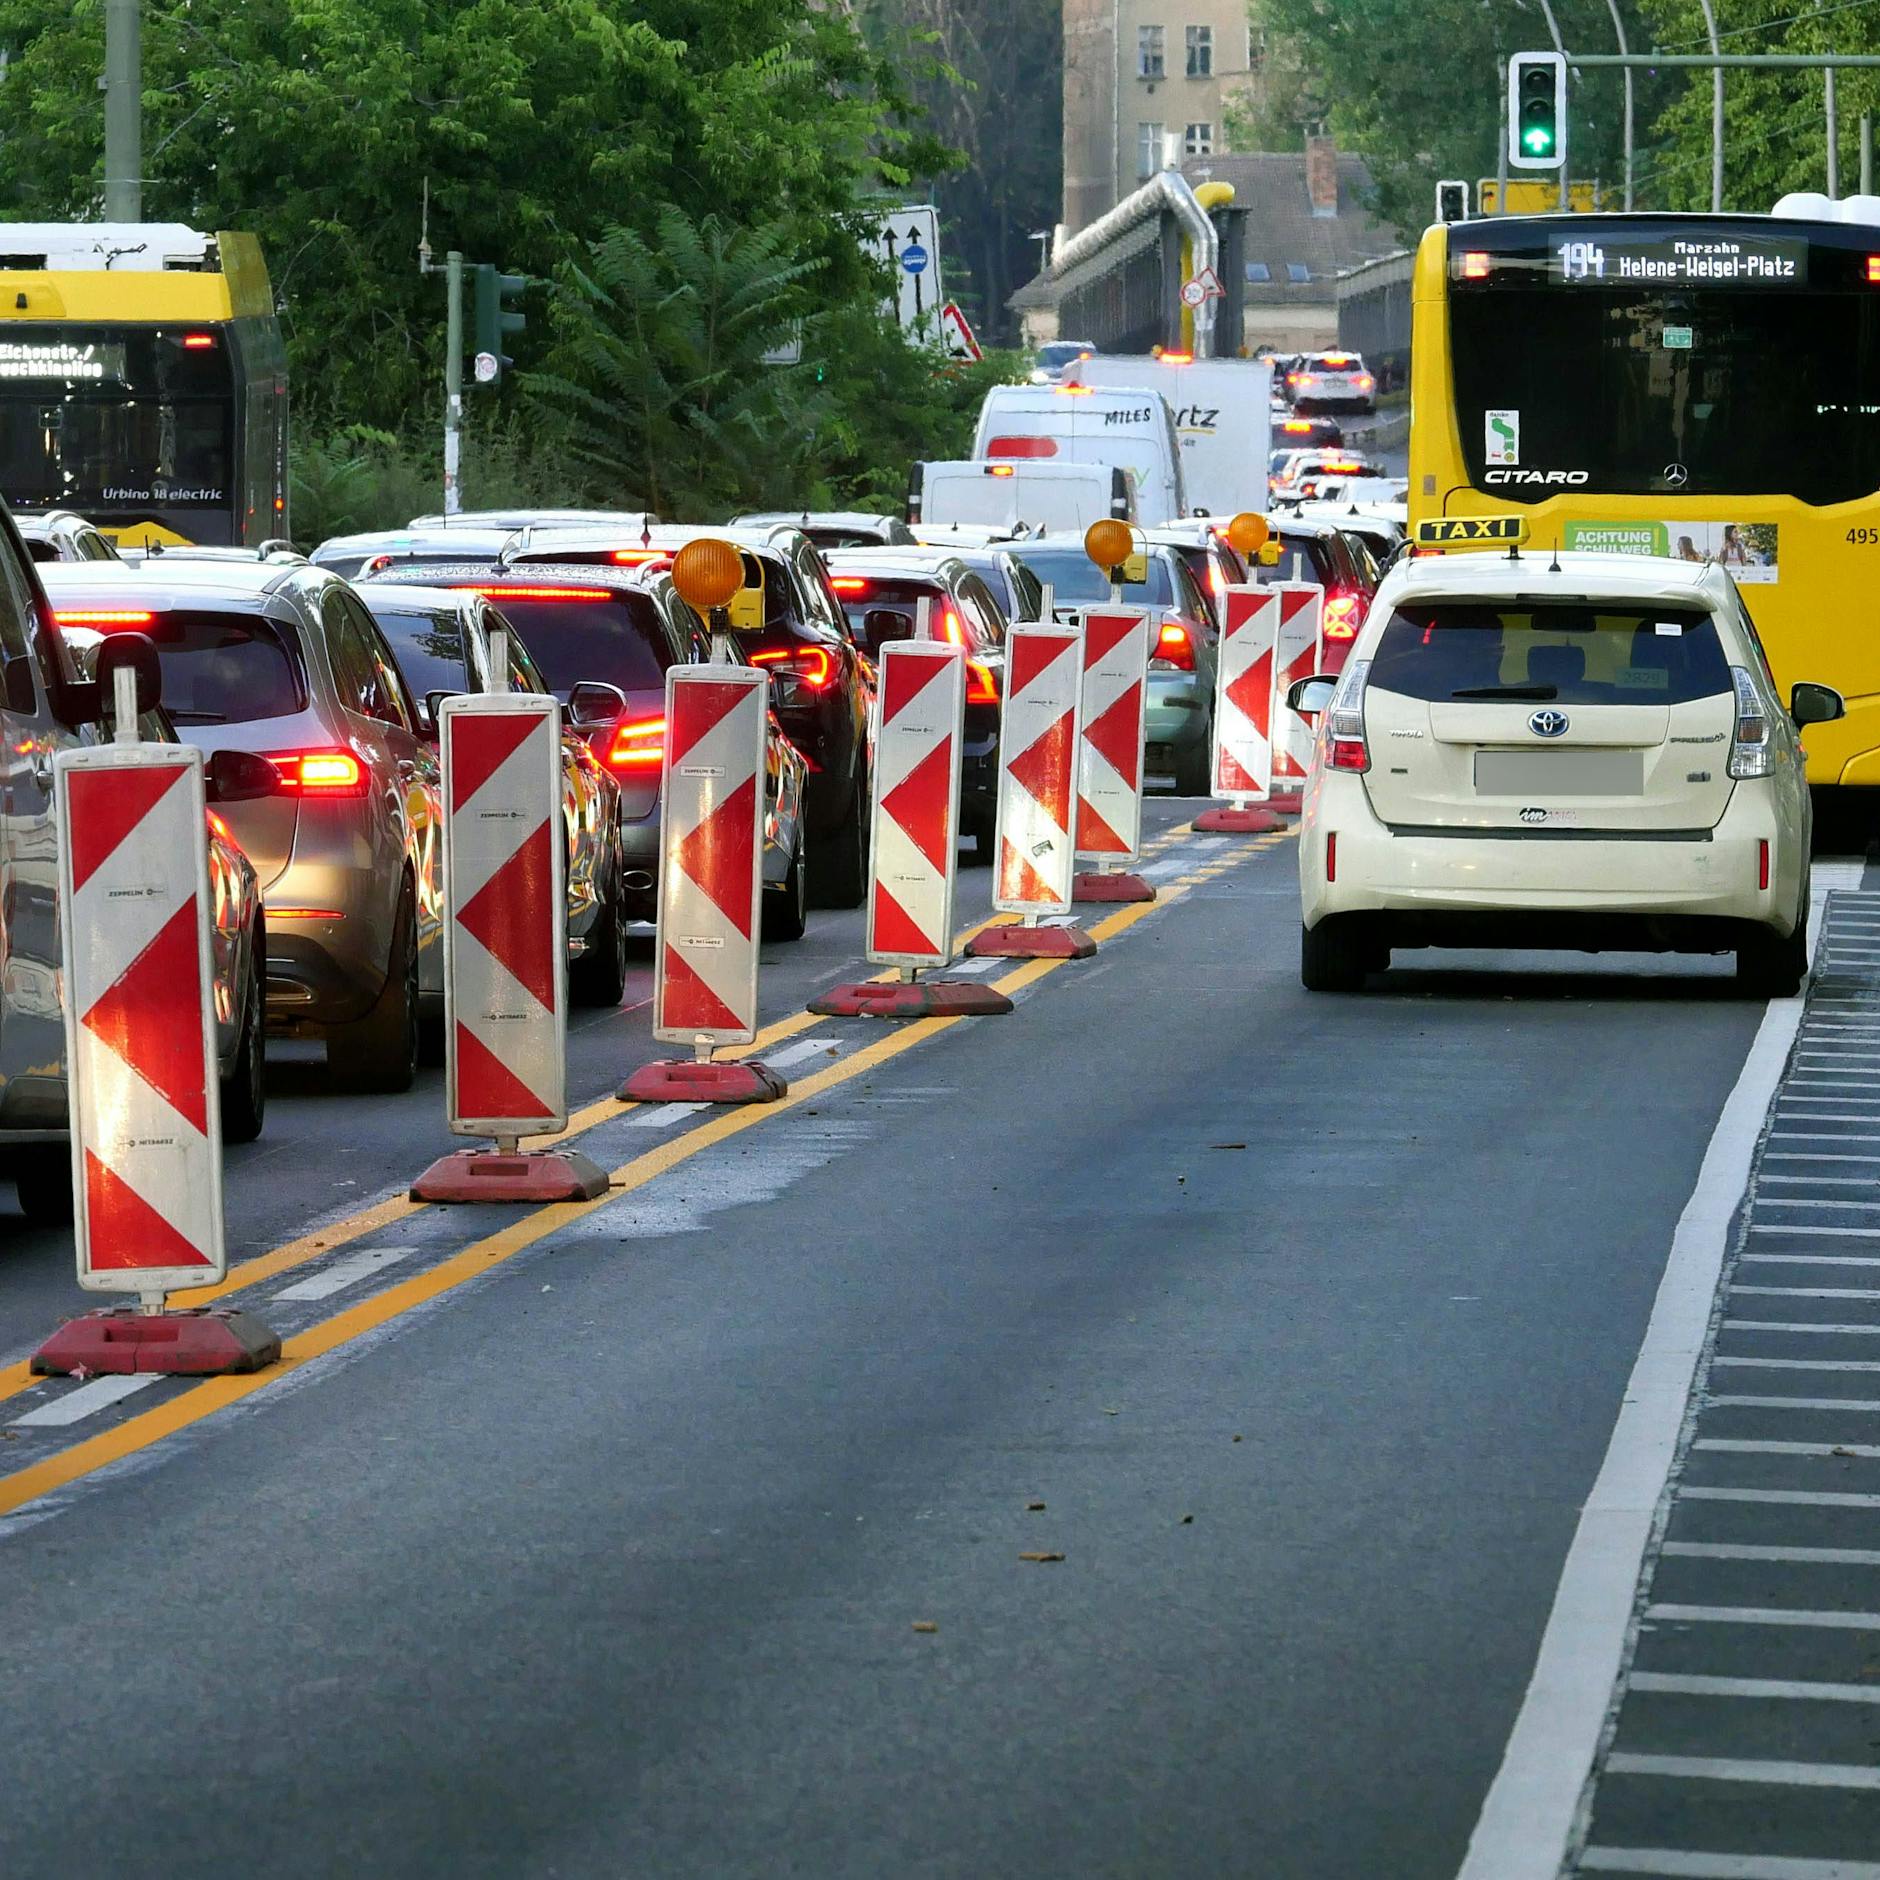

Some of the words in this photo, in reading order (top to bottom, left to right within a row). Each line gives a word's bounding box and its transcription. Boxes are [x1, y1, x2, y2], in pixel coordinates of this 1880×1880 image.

[1674, 242, 1740, 254] Marzahn
[1558, 242, 1604, 278] 194
[1620, 255, 1795, 277] Helene-Weigel-Platz
[1104, 408, 1151, 426] MILES
[1485, 470, 1589, 485] CITARO
[103, 488, 149, 499] Urbino
[154, 488, 167, 499] 18
[169, 488, 222, 499] electric
[1431, 520, 1506, 540] TAXI
[1575, 531, 1652, 543] ACHTUNG
[1846, 528, 1878, 544] 495
